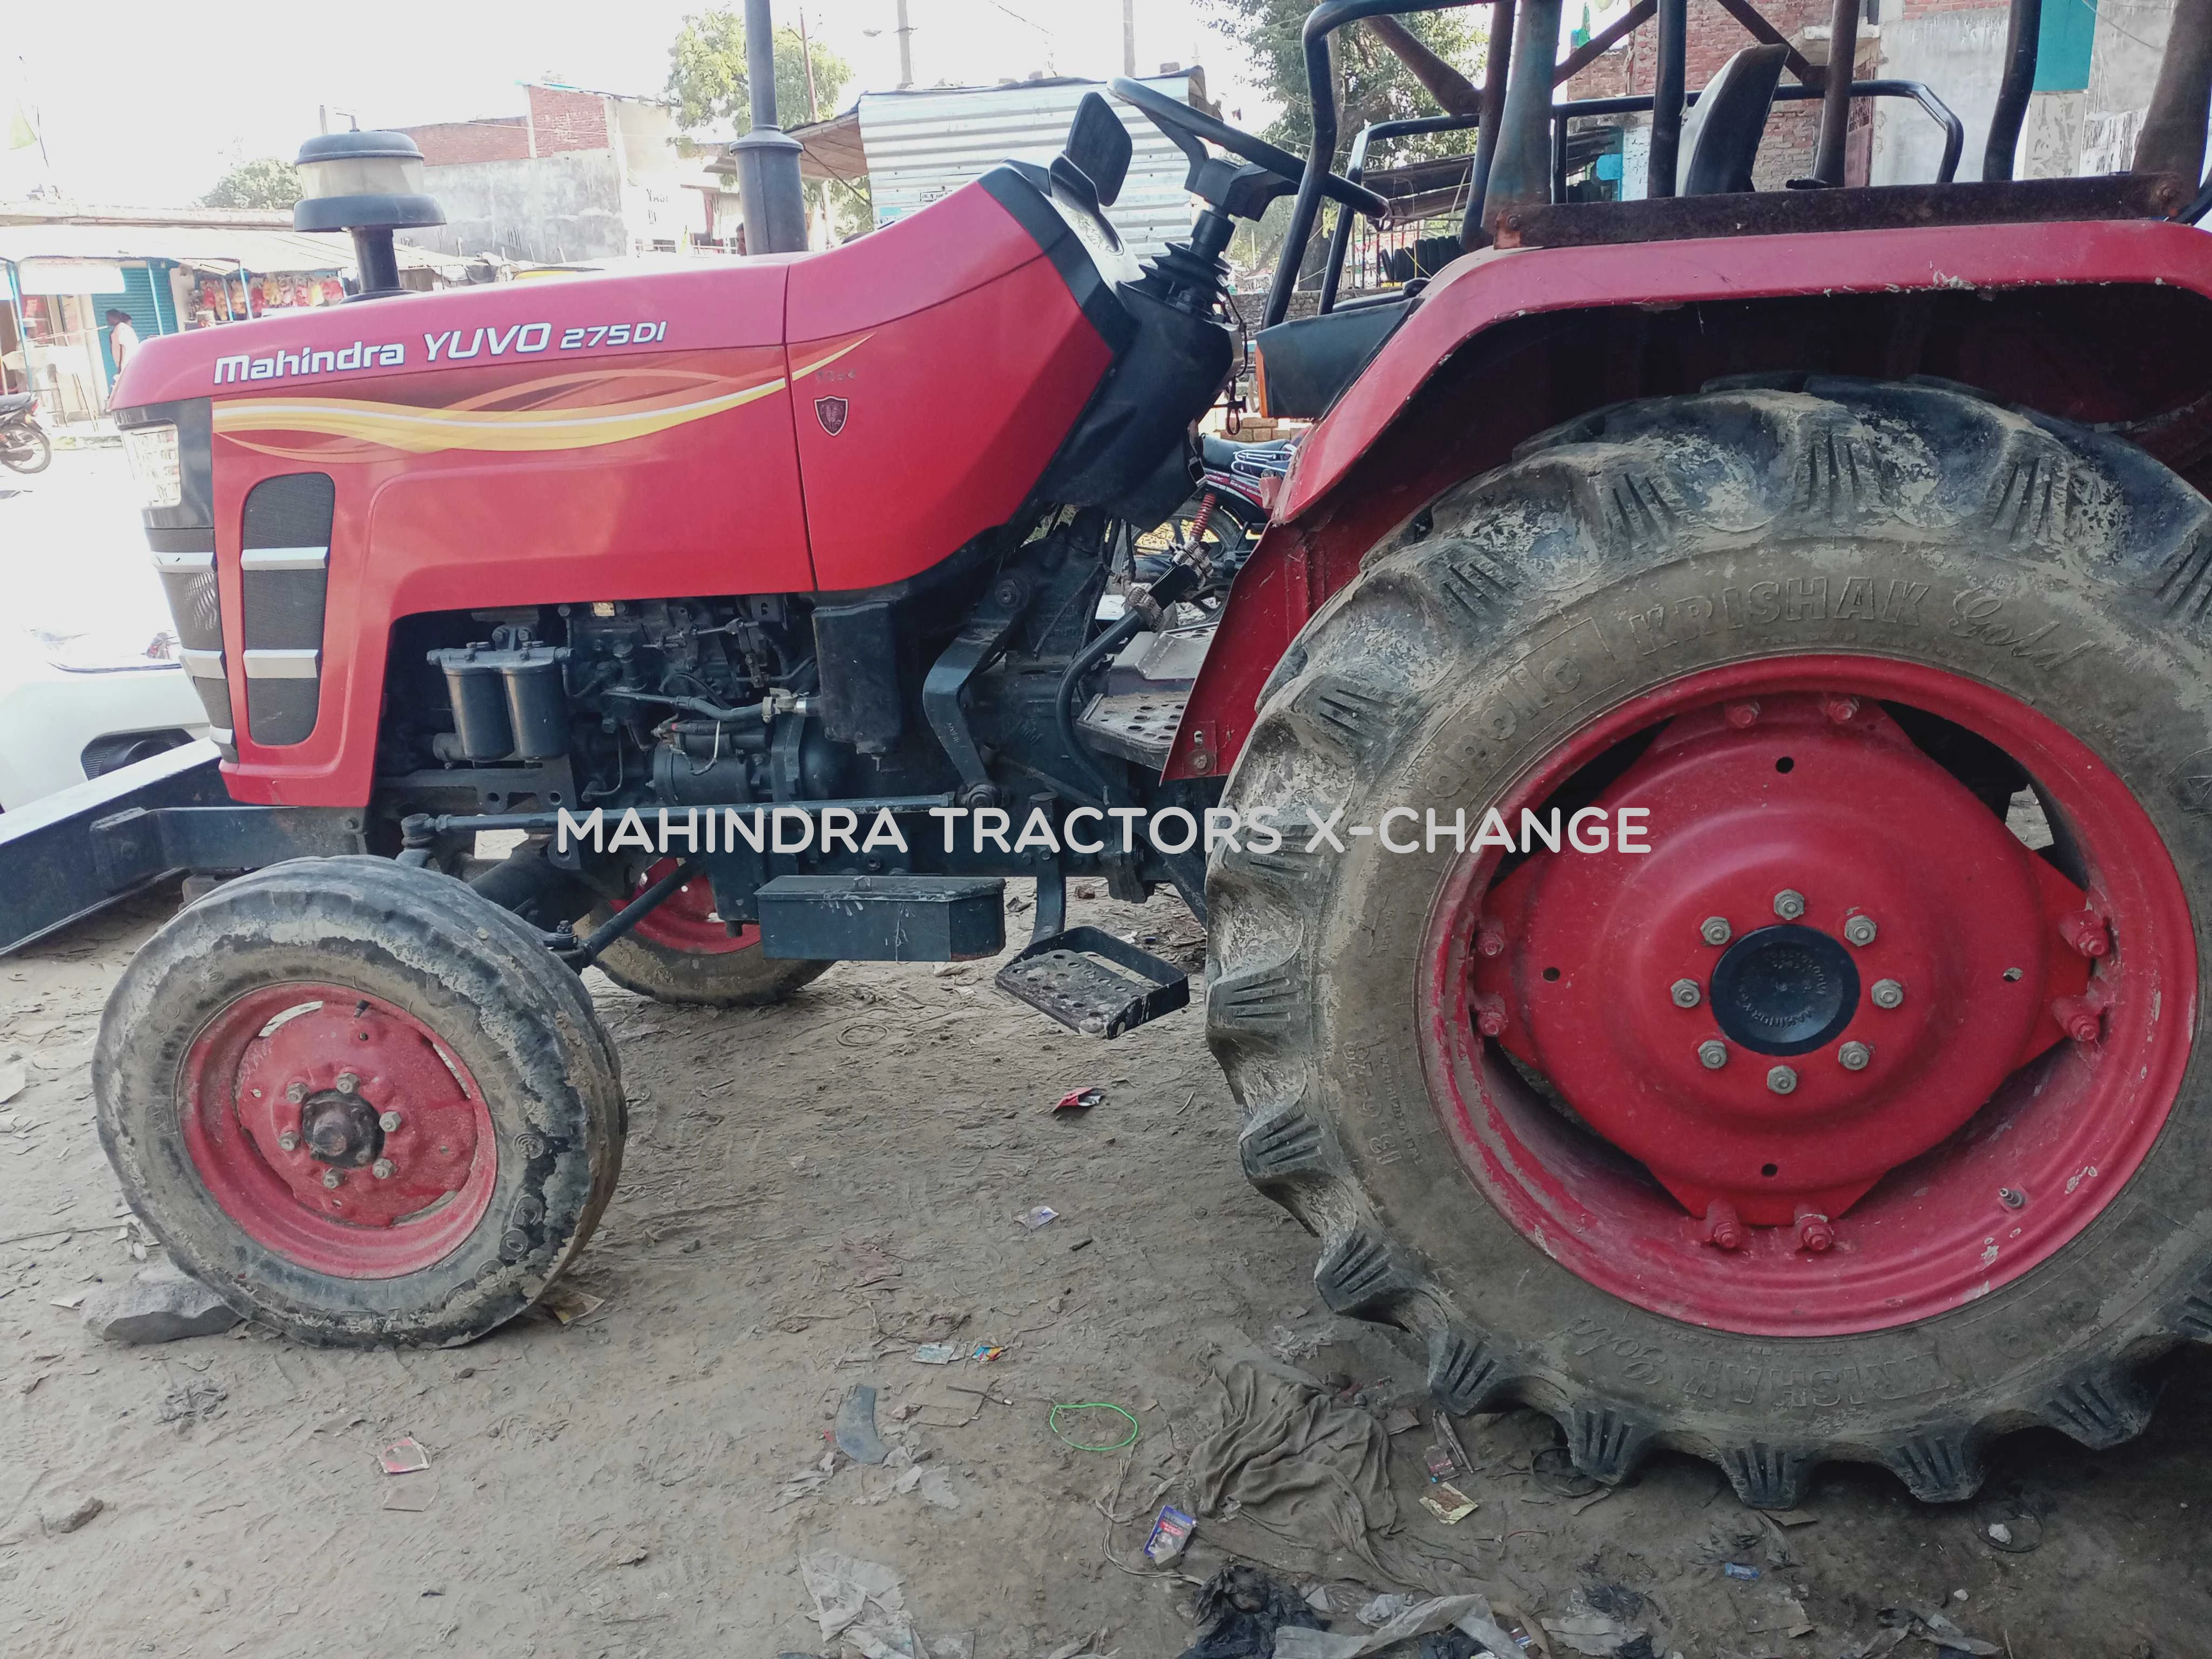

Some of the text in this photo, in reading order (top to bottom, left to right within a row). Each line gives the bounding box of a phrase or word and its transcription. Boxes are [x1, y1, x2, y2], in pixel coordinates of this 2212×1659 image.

[213, 340, 406, 385] Mahindra
[423, 321, 552, 362] YUVO
[1628, 576, 1930, 656] KRISHAK
[1948, 585, 2098, 672] Gold
